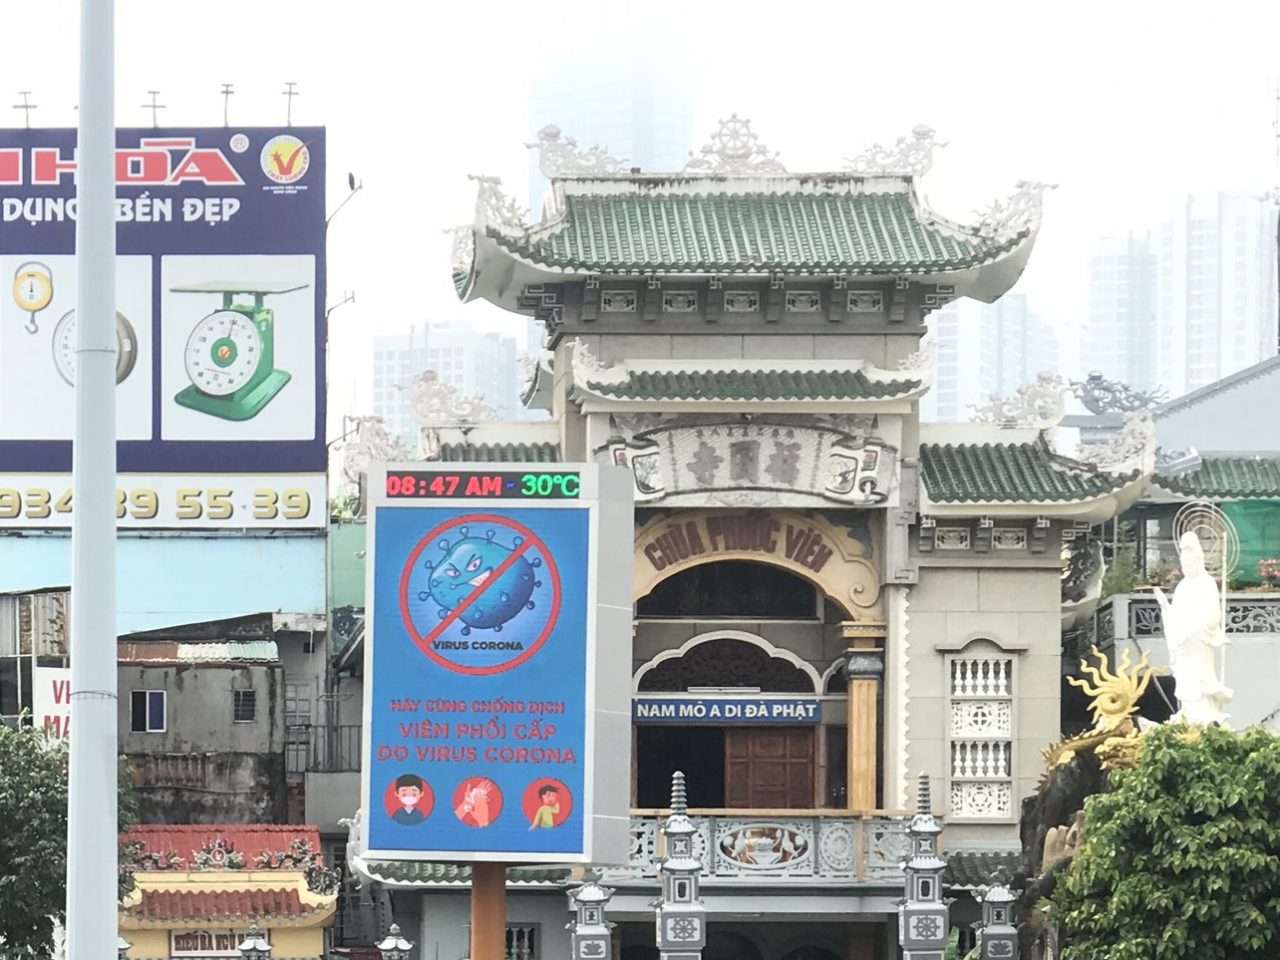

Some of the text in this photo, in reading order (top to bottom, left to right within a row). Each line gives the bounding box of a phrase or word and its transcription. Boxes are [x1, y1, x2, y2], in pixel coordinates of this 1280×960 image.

[182, 197, 240, 226] ĐẸP
[465, 477, 502, 495] AM
[175, 487, 234, 519] 55
[252, 488, 311, 519] 39
[644, 521, 706, 571] CHÙA
[433, 640, 524, 650] VIRUS CORONA
[637, 701, 817, 720] NAM MÔ A DI ĐÀ PHẬT
[400, 719, 449, 739] VIÊM
[376, 745, 577, 764] DO VIRUS CORONA
